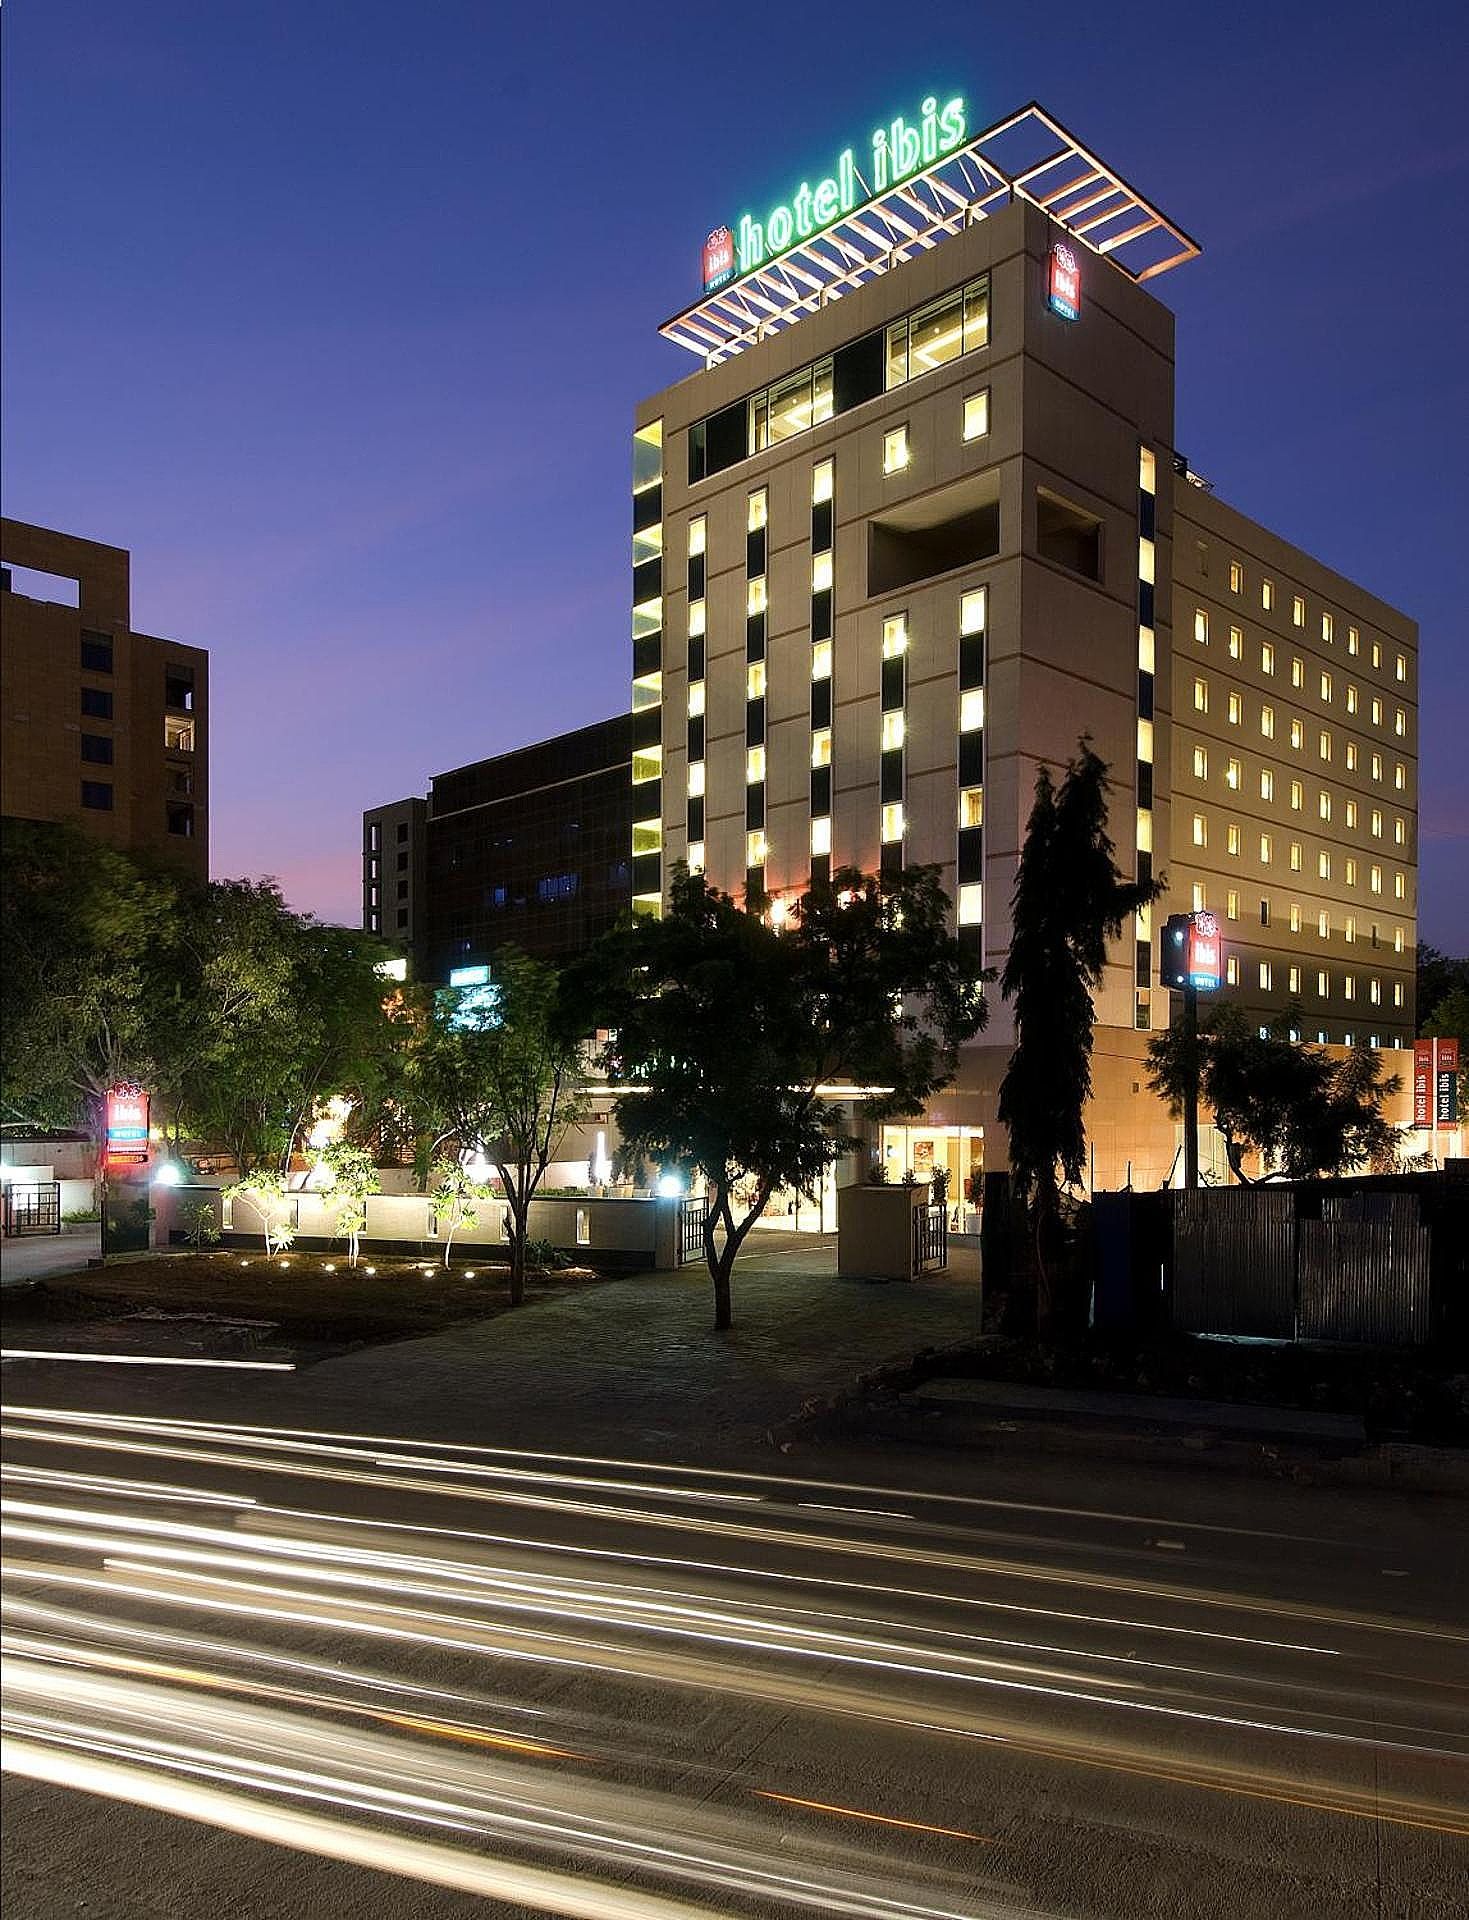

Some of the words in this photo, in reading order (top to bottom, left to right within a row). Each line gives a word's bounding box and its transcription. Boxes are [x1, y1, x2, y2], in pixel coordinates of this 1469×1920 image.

[738, 148, 854, 272] hotel
[872, 96, 967, 193] ibis
[709, 249, 730, 273] ibis
[1055, 268, 1076, 299] ibis
[1194, 940, 1217, 965] ibis
[1194, 976, 1216, 988] HOTEL
[1416, 1074, 1426, 1093] ibis
[1438, 1073, 1450, 1092] ibis
[114, 1103, 142, 1121] ibis
[1416, 1096, 1426, 1120] hotel
[1438, 1095, 1450, 1120] hotel
